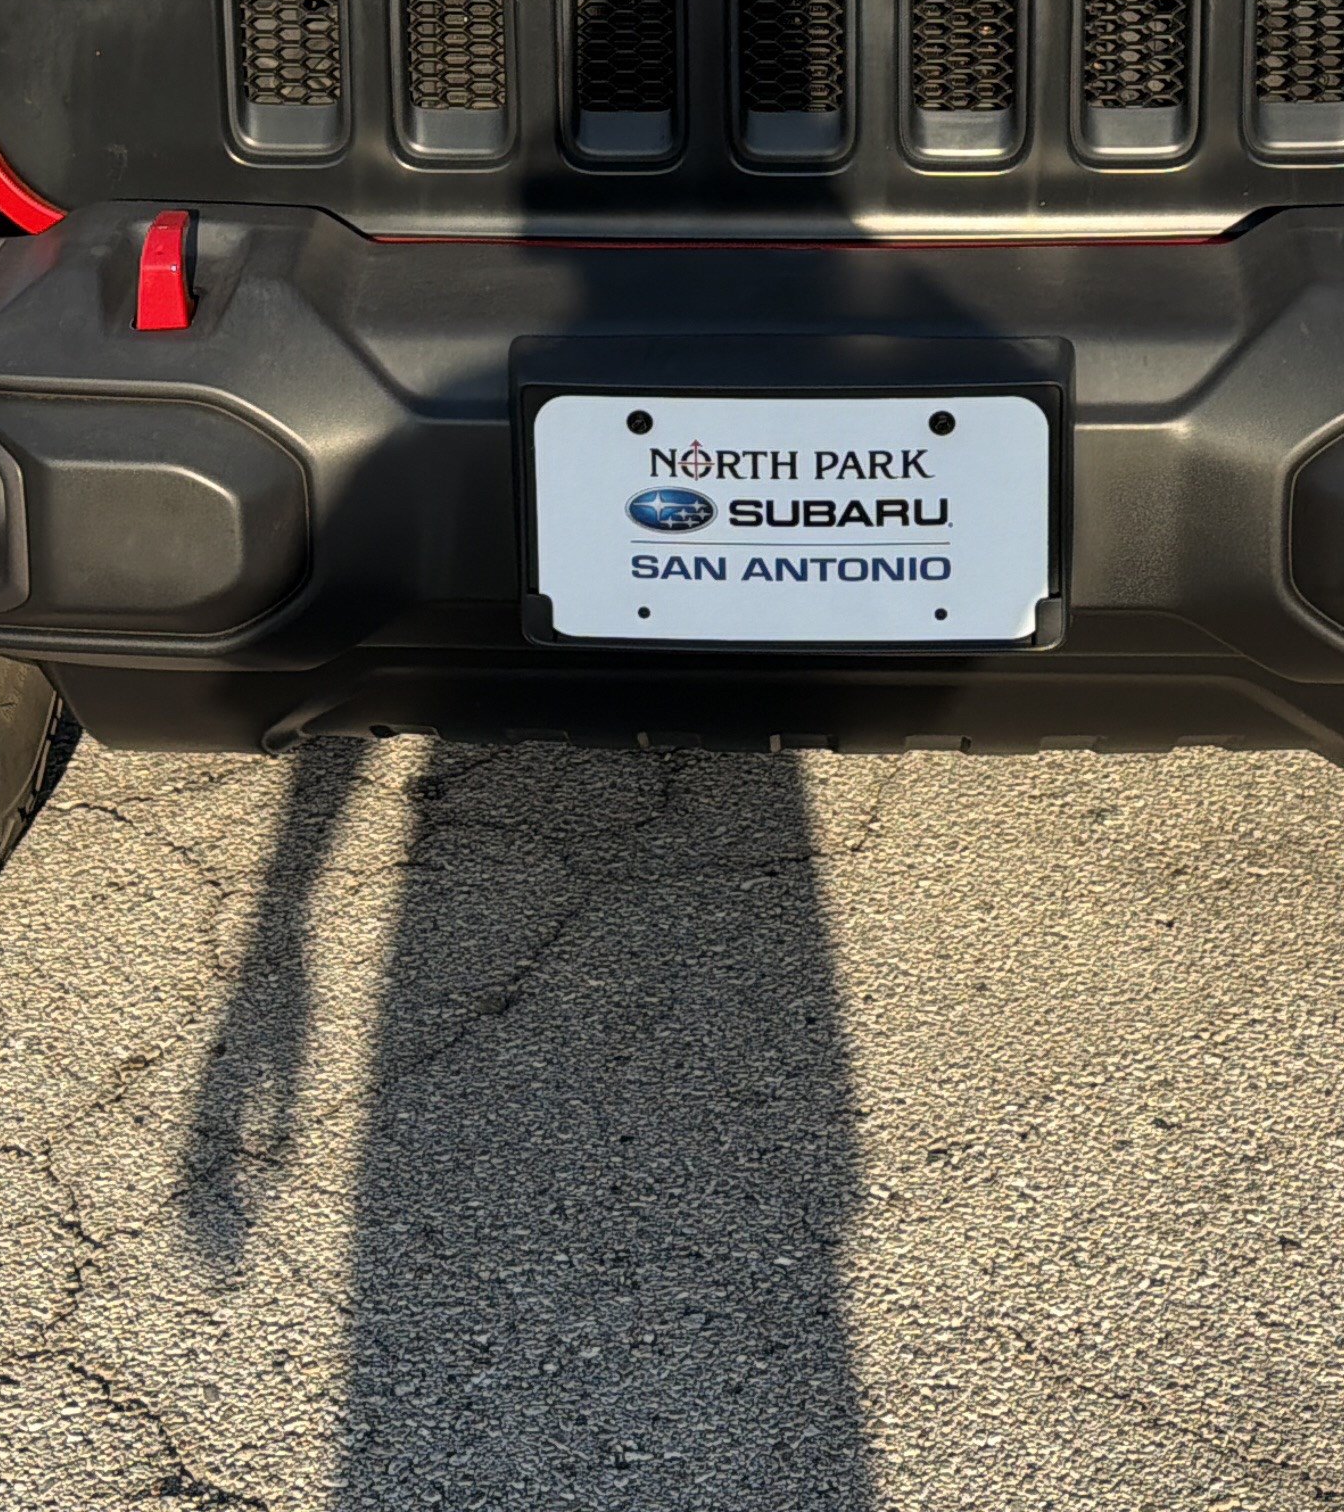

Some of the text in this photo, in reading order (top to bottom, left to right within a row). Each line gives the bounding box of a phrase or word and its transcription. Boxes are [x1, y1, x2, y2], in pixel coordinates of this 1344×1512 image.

[649, 443, 935, 480] NORTH PARK
[729, 498, 949, 528] SUBARU
[631, 555, 952, 582] SAN ANTONIO
